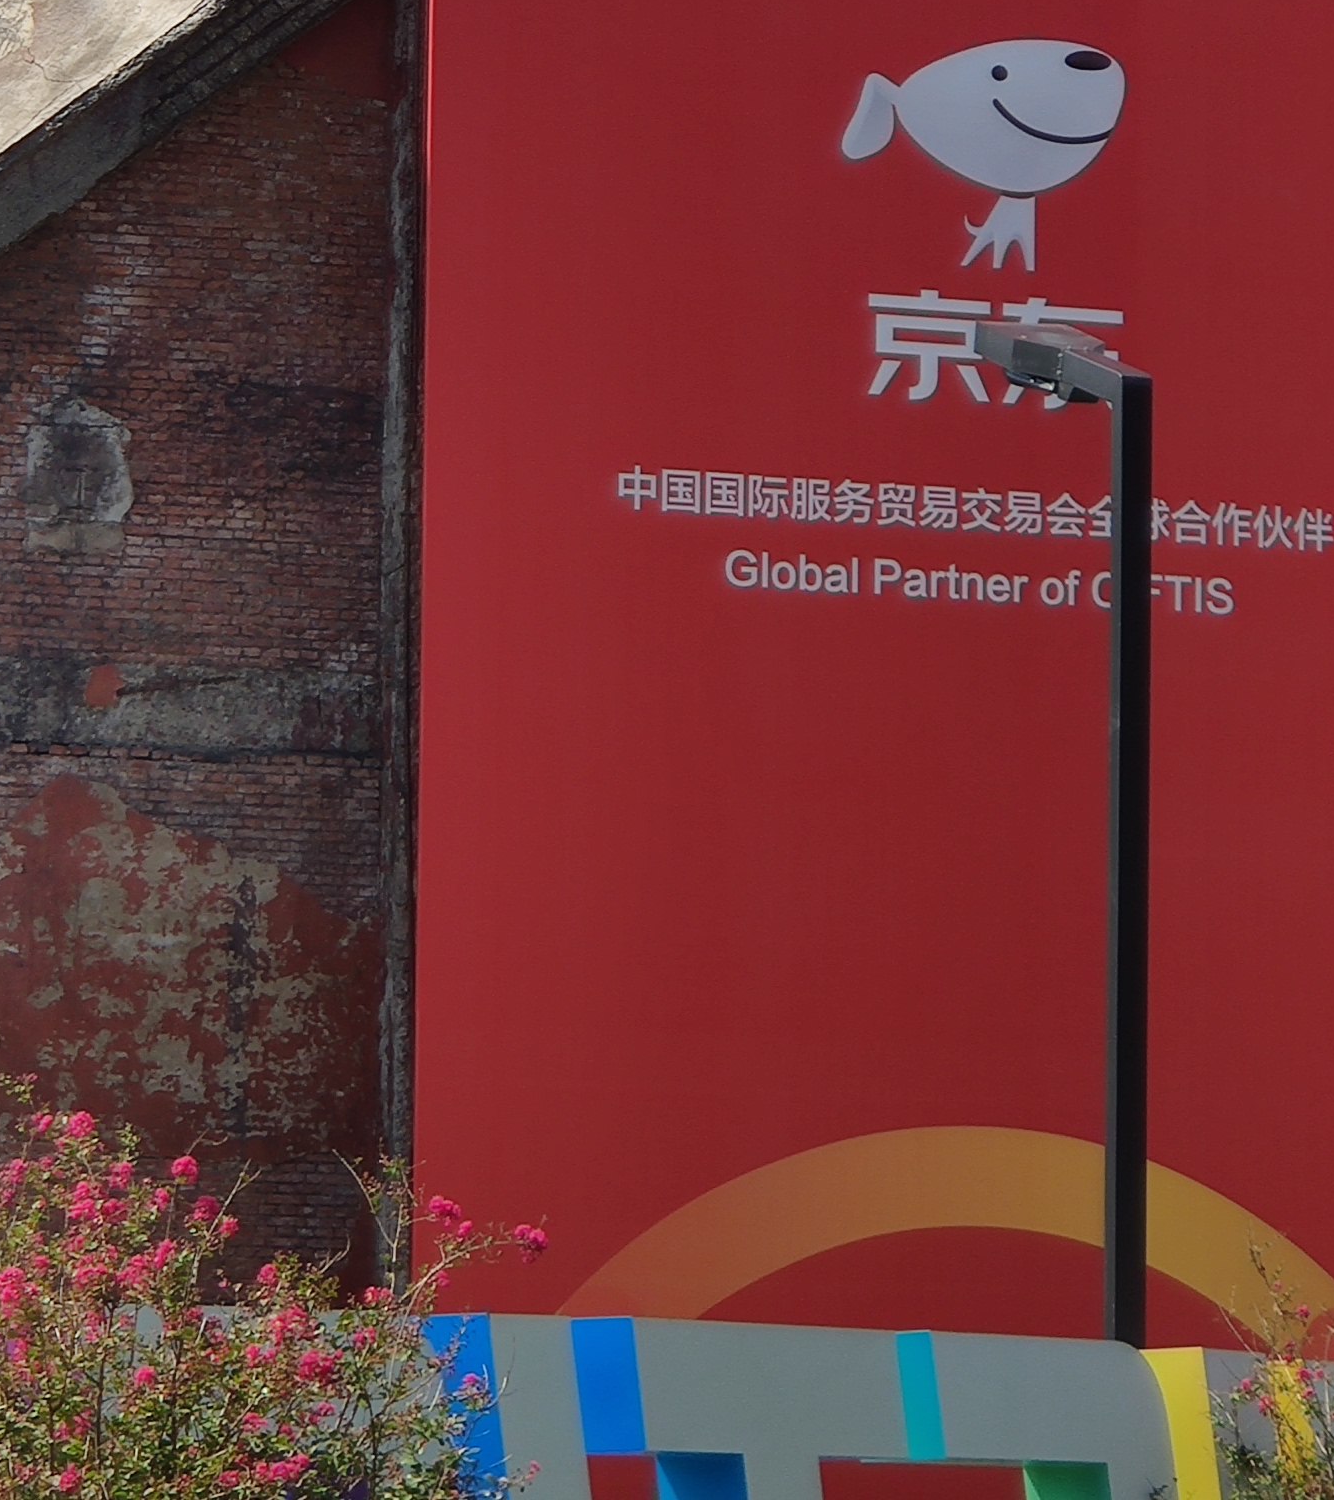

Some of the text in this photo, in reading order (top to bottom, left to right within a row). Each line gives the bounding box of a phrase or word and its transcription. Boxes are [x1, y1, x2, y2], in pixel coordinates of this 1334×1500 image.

[724, 549, 1235, 615] Global Partner of CFTIS
